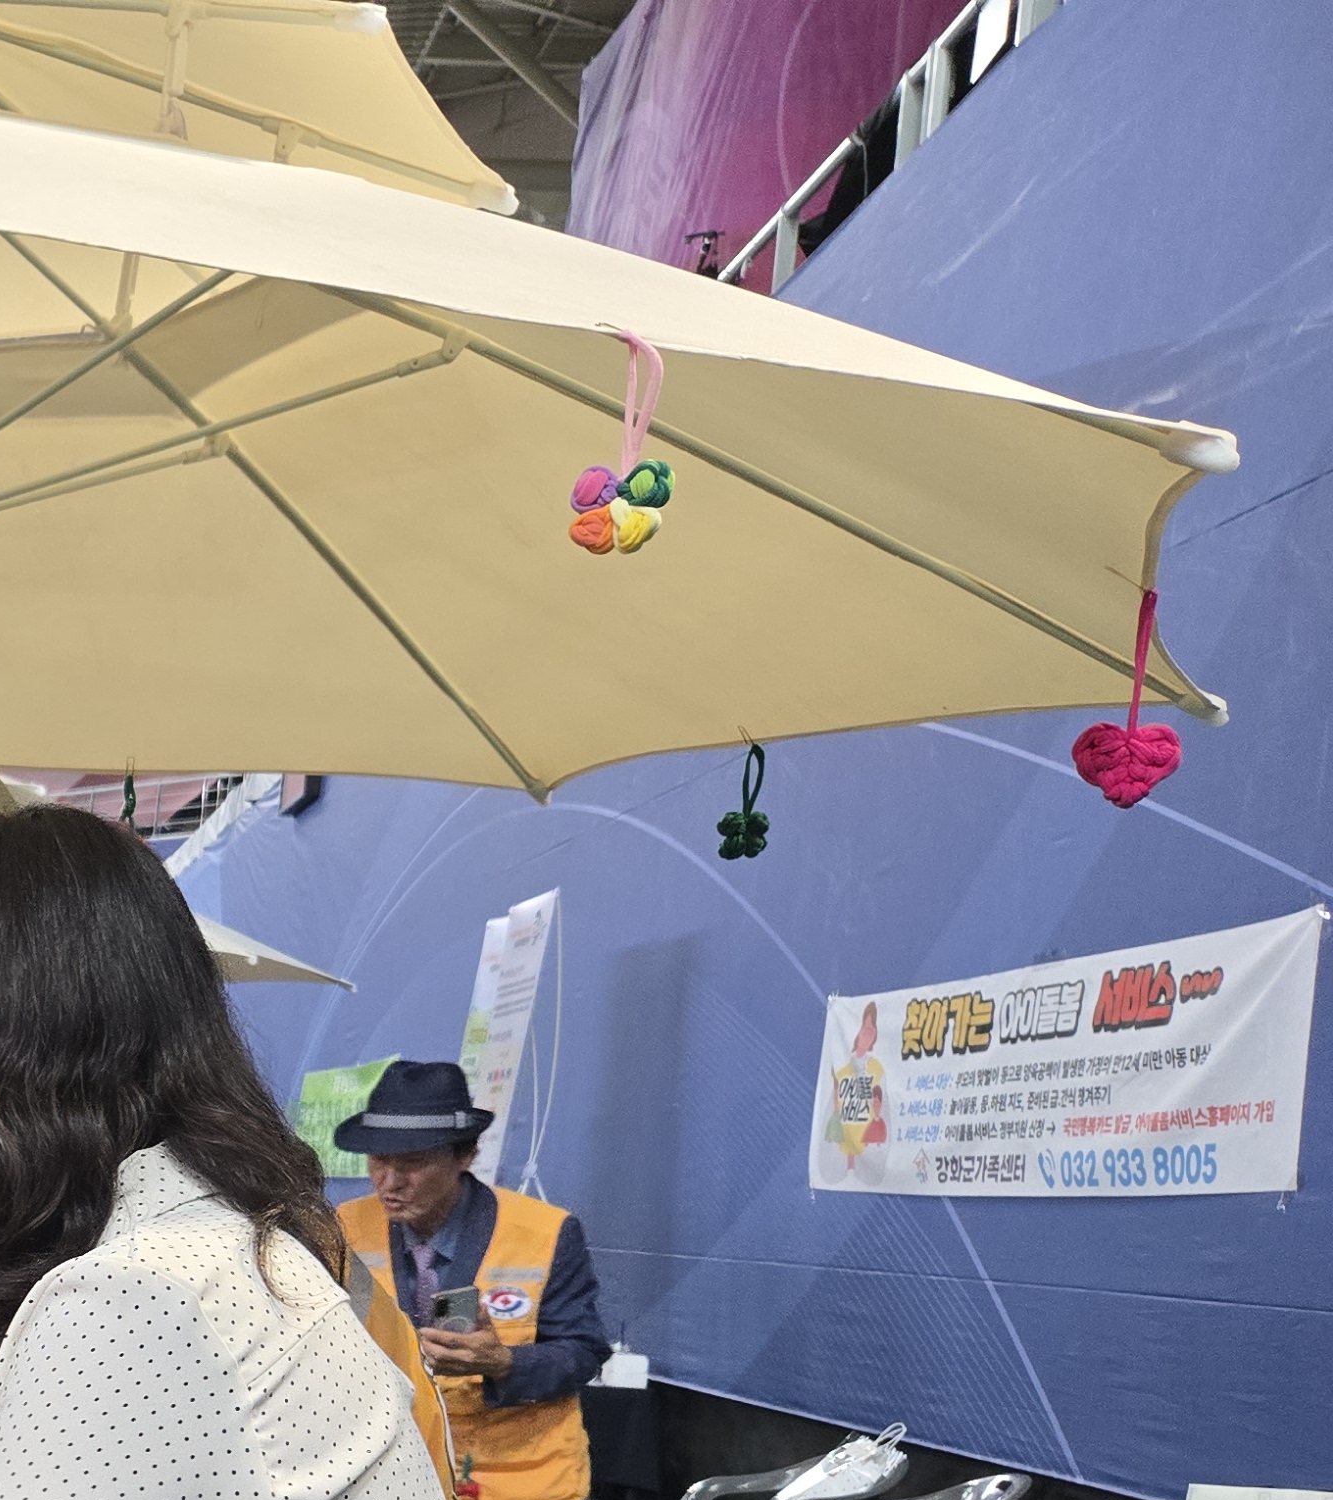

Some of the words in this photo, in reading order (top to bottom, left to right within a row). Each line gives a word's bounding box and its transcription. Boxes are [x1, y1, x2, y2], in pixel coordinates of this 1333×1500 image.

[999, 979, 1085, 1044] 아이돌봄
[1093, 961, 1177, 1033] 서비스
[976, 1067, 1000, 1086] 맞벌이
[1001, 1065, 1023, 1085] 등으로
[1023, 1062, 1062, 1081] 양육공백이
[1062, 1057, 1086, 1079] 발생한
[1086, 1055, 1111, 1076] 가정의
[1142, 1050, 1163, 1071] 미만
[1165, 1047, 1187, 1068] 아동
[1190, 1044, 1212, 1065] 대상
[839, 1076, 874, 1099] 아이돌봄
[1027, 1089, 1050, 1111] 준비된
[1078, 1085, 1111, 1107] 챙겨주기
[841, 1099, 870, 1122] 서비스
[999, 1119, 1028, 1140] 정부지원
[1028, 1118, 1045, 1138] 신청
[1063, 1114, 1113, 1137] 국민행복카드
[1253, 1099, 1276, 1123] 가입
[935, 1154, 1026, 1183] 강화군가족센터
[1060, 1149, 1100, 1188] 032
[1102, 1147, 1147, 1187] 933
[1152, 1143, 1218, 1186] 8005
